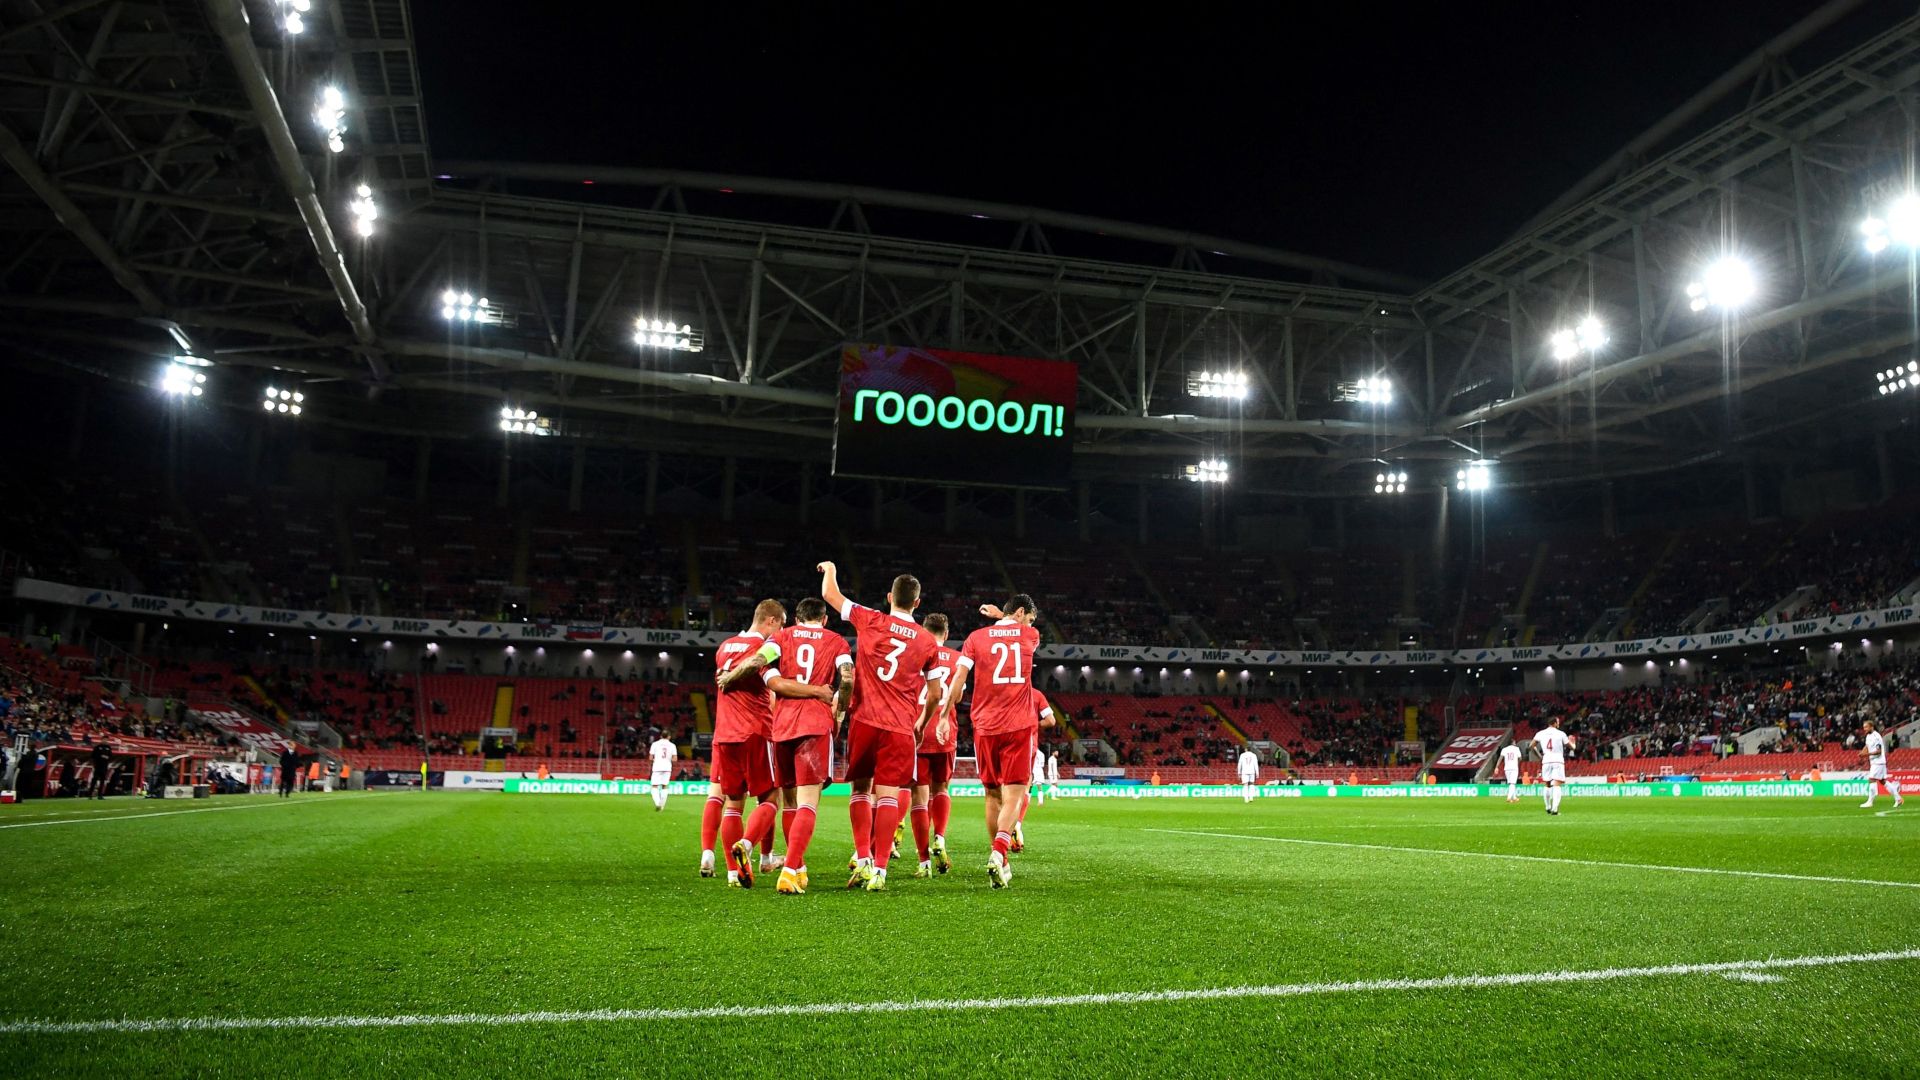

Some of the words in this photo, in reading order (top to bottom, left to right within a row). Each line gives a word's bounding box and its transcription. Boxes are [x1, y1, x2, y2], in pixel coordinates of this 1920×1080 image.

[854, 389, 1064, 437] ГОООООЛ!
[131, 596, 168, 611] МИР
[261, 609, 298, 624] МИР
[1885, 608, 1914, 623] МИР
[393, 620, 430, 632] МИР
[890, 622, 917, 640] DIVEEV
[989, 628, 1021, 637] EROKHIN
[1793, 622, 1818, 635] МИР
[647, 631, 681, 643] МИР
[793, 629, 823, 640] SMOLOV
[1710, 633, 1735, 645] МИР
[1100, 647, 1130, 658] МИР
[1512, 648, 1543, 659] МИР
[1615, 642, 1643, 654] МИР
[877, 637, 907, 682] 3
[1202, 650, 1231, 661] МИР
[1302, 653, 1331, 663] МИР
[1407, 652, 1437, 662] МИР
[796, 643, 815, 685] 9
[991, 642, 1026, 685] 21
[1546, 738, 1553, 752] 4
[519, 781, 619, 794] ПОДКЛЮЧАЙ
[623, 782, 683, 795] ПЕРЙ
[1138, 784, 1189, 797] ПЕРВЫЙ
[1192, 785, 1259, 797] СЕМЕЙНЙ
[1263, 787, 1302, 797] ТАРИФ
[1362, 787, 1407, 797] ГОВОРИ
[1410, 787, 1478, 797] БЕСПЛАТНО
[1571, 784, 1619, 797] СЕМЕЙНЫЙ
[1622, 786, 1651, 796] ТАРИФ
[1702, 785, 1744, 796] ГОВОРИ
[1746, 784, 1813, 796] БЕСПЛАТНО
[1833, 783, 1869, 796] ПОДК
